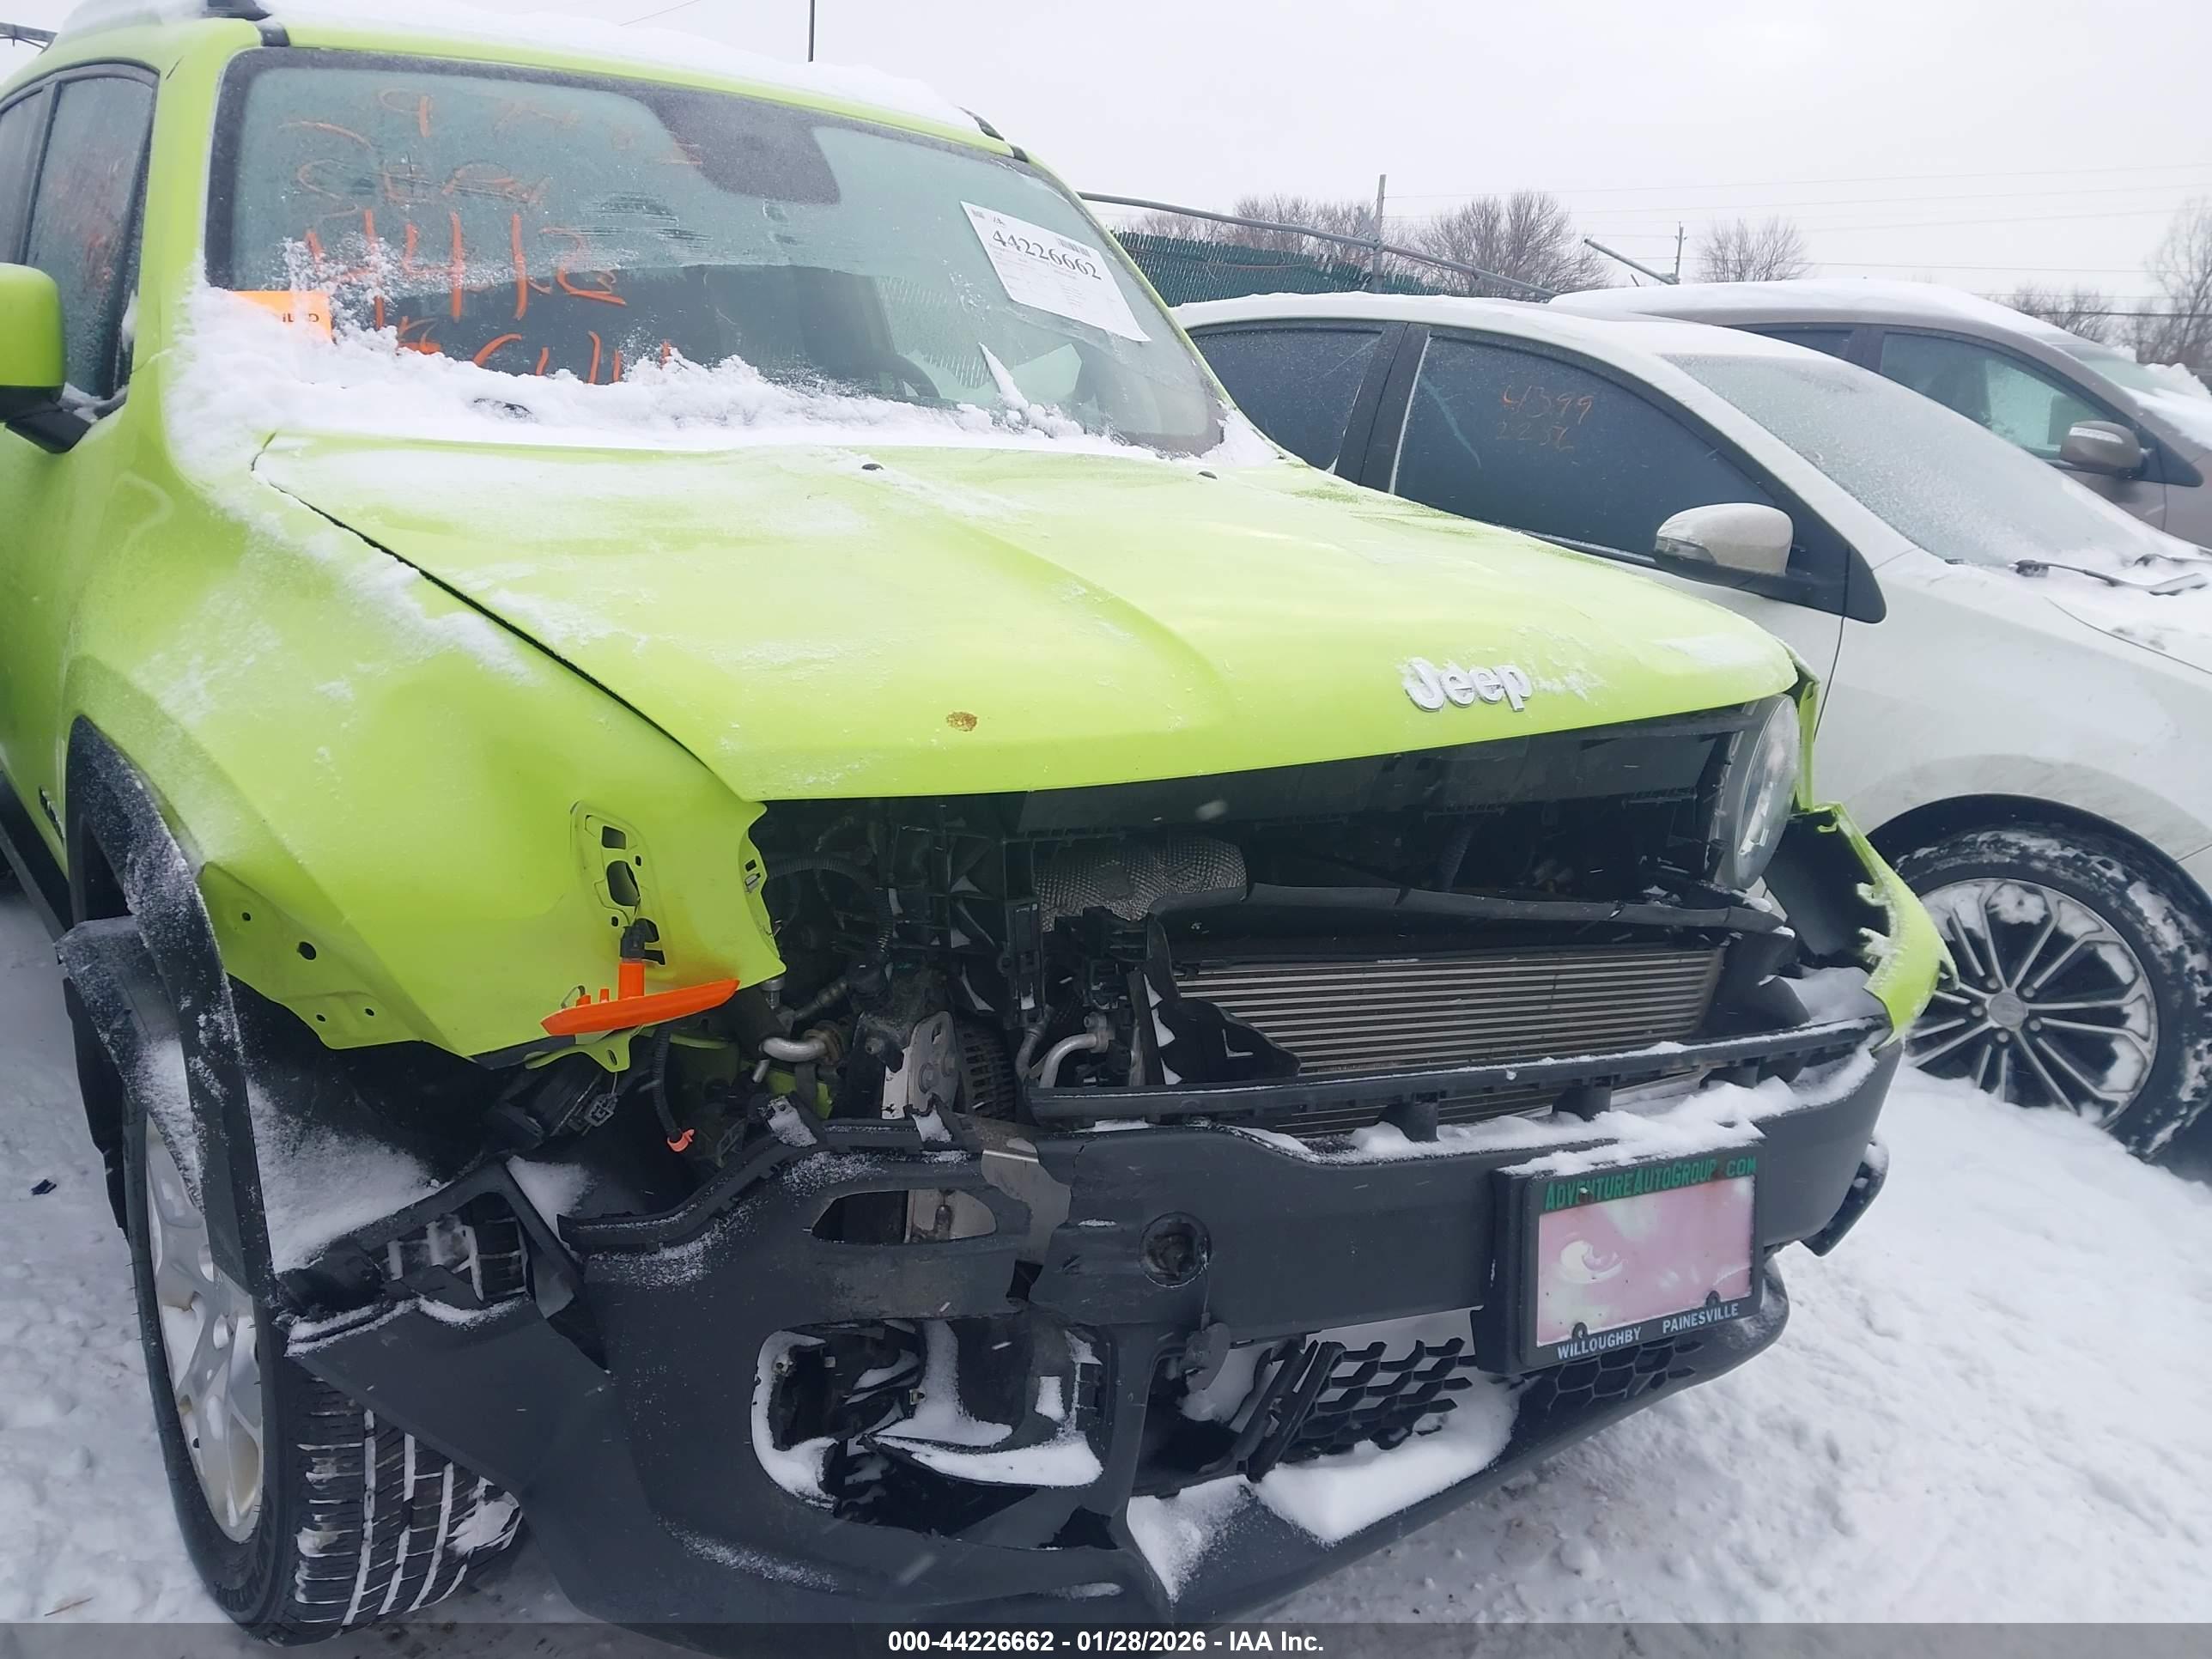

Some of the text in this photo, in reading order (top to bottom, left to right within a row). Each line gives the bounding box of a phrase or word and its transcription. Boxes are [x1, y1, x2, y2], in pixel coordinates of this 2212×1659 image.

[992, 229, 1103, 281] 44226662
[1402, 657, 1534, 713] Jeep
[1556, 1302, 1740, 1360] WILLOUGHBY PAINESVILLE
